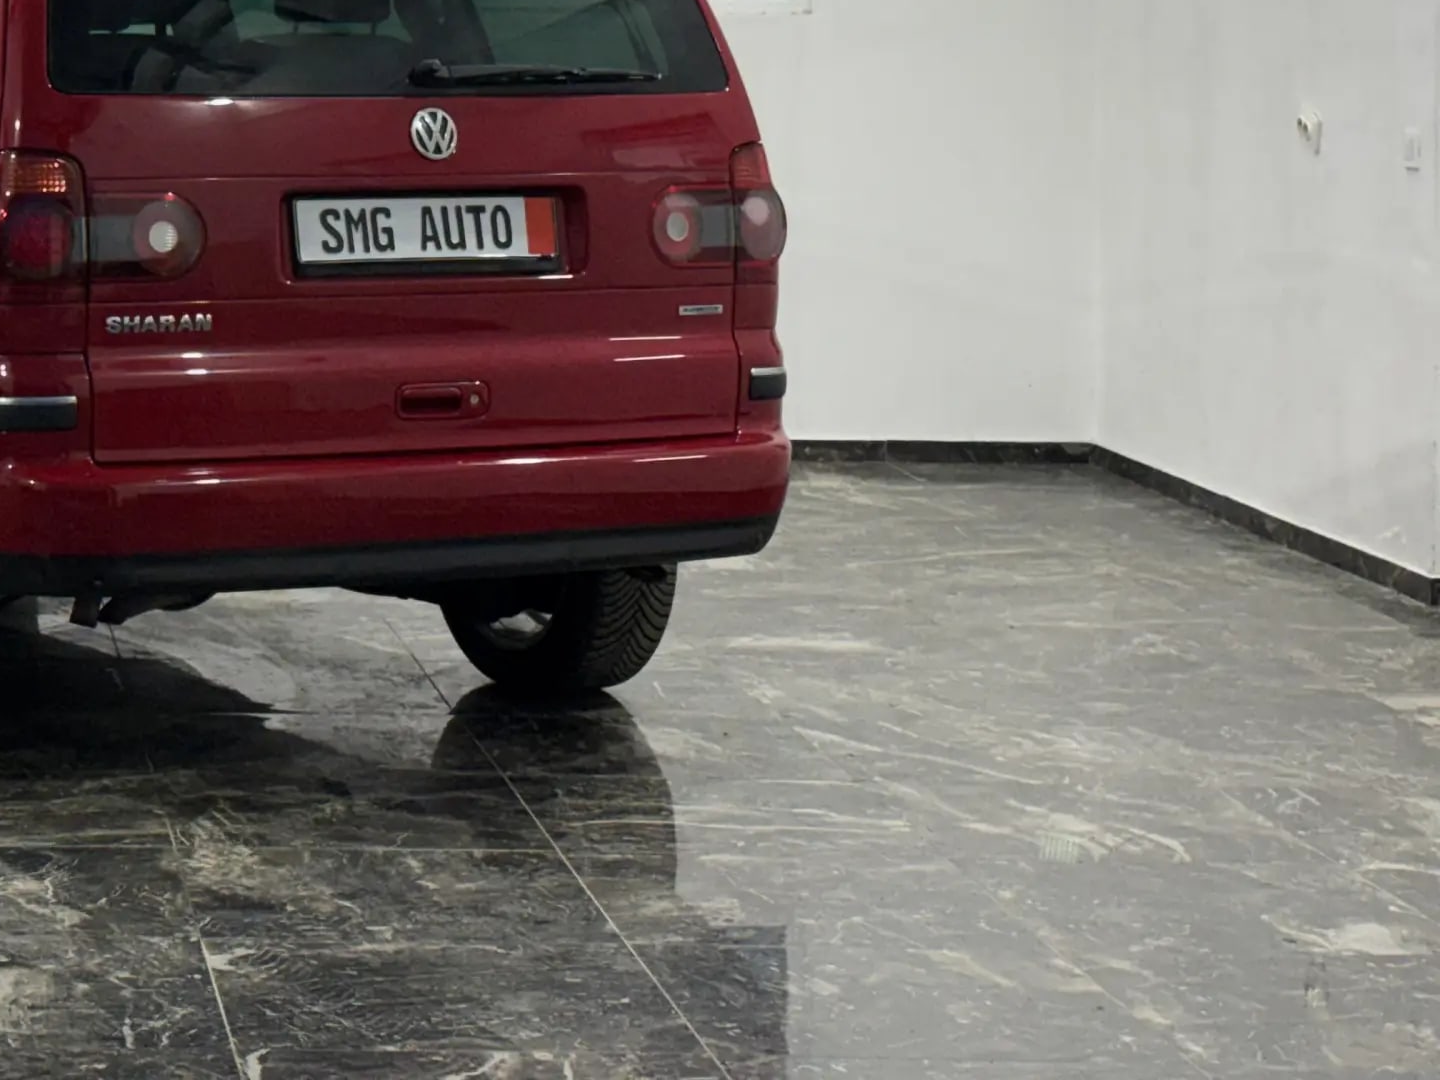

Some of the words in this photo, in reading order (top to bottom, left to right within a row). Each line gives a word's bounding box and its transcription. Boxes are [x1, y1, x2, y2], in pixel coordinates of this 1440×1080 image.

[319, 207, 396, 254] SMG
[421, 204, 513, 251] AUTO
[105, 313, 213, 334] SHARAN
